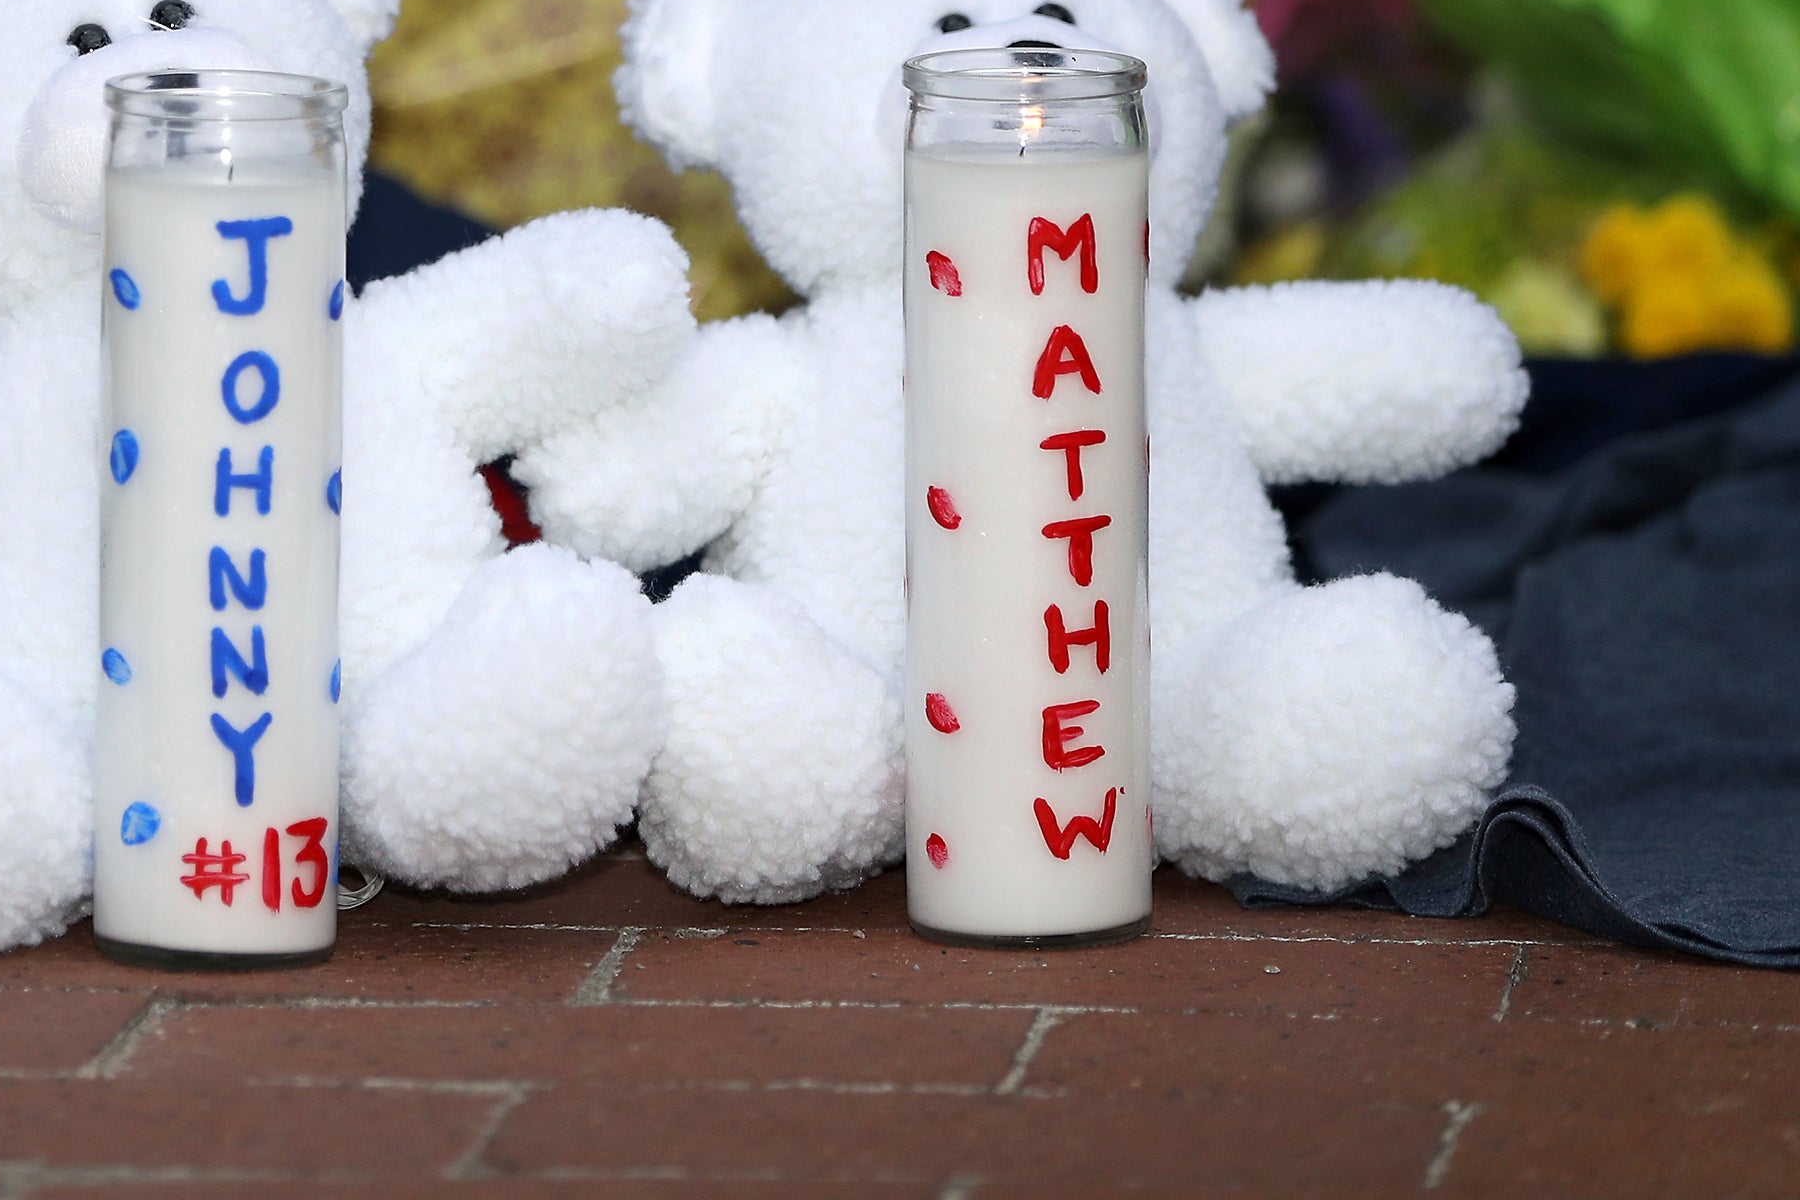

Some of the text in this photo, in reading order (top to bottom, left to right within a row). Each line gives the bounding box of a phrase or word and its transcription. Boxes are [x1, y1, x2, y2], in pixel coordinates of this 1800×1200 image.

[210, 215, 294, 808] JOHNNY
[1025, 211, 1119, 862] MATTHEW
[179, 815, 330, 914] #13
